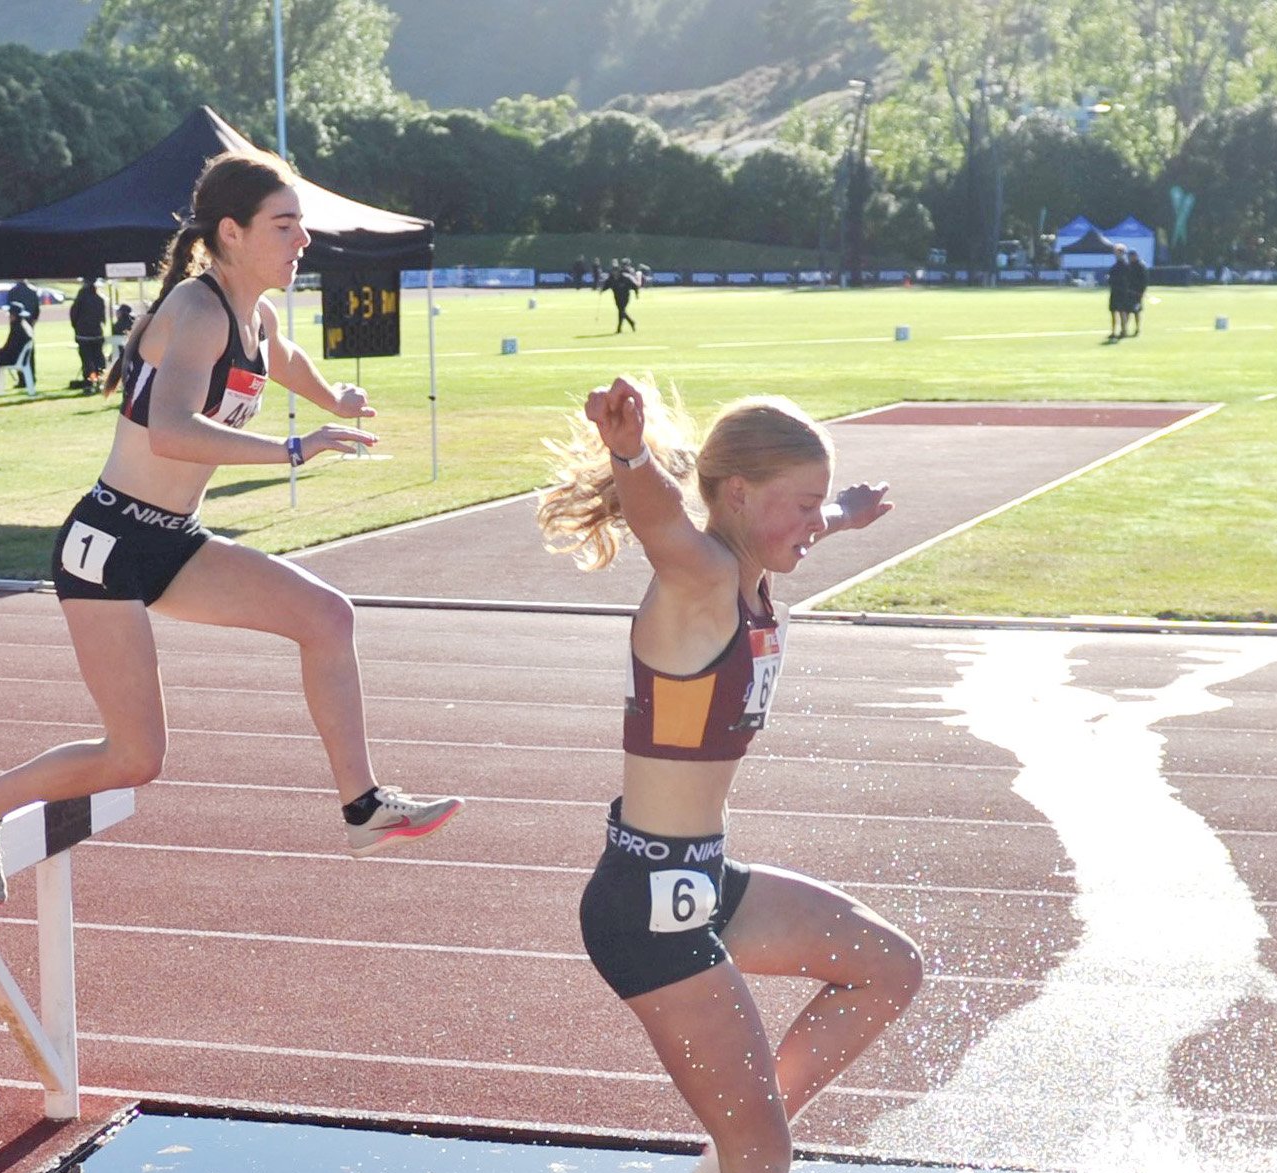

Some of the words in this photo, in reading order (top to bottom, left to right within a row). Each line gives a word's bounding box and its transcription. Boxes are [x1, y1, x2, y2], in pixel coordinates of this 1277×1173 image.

[121, 502, 184, 530] NIKE
[81, 534, 95, 570] 1
[617, 830, 671, 860] PRO
[672, 877, 696, 923] 6
